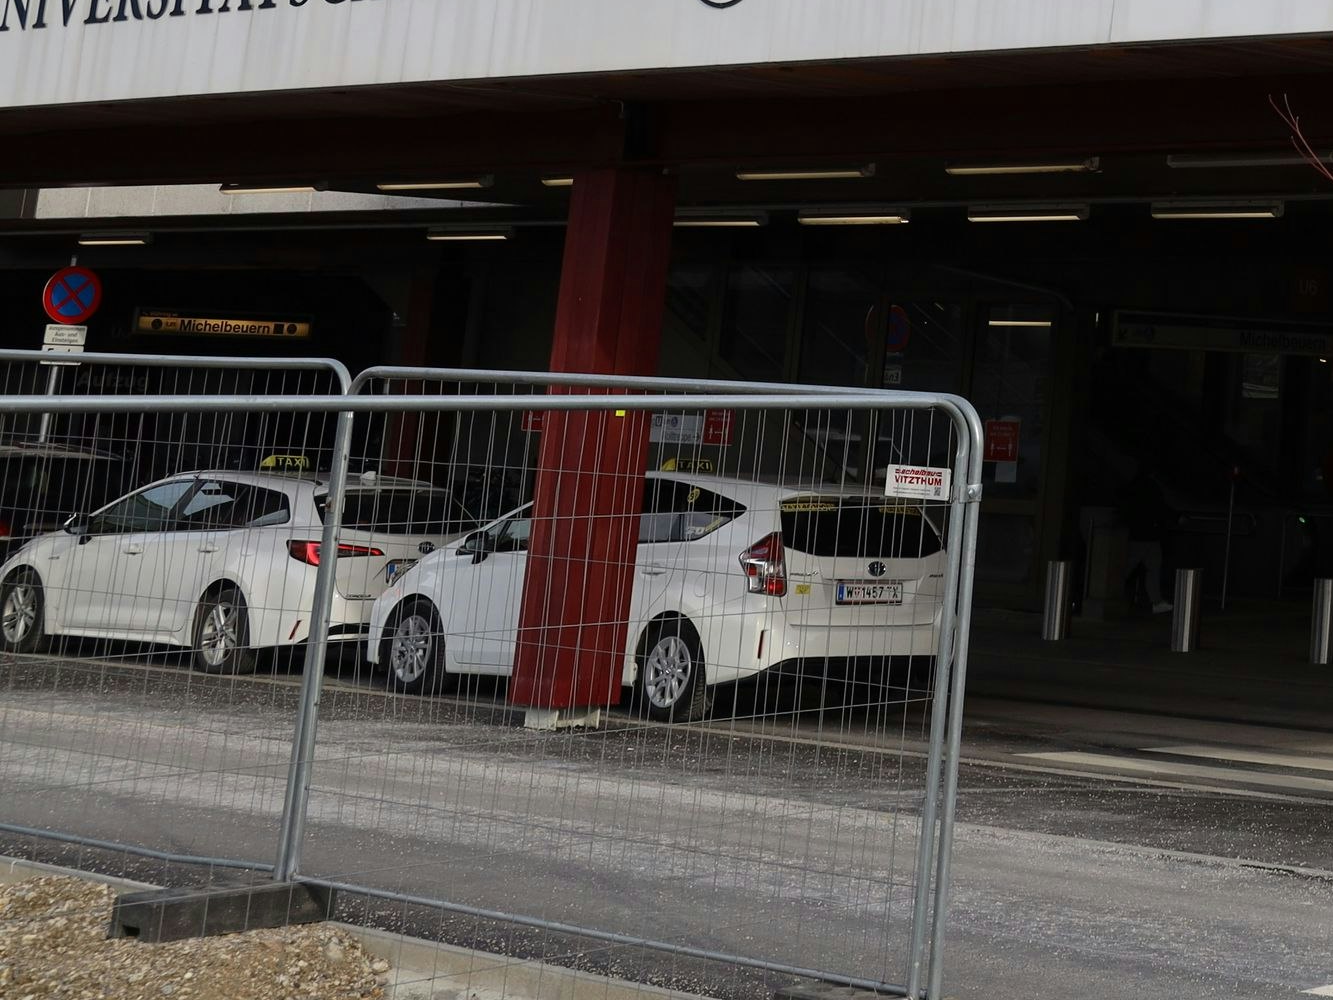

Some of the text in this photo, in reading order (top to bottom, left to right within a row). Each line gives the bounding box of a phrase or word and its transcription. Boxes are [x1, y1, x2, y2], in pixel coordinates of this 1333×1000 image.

[179, 319, 271, 335] Michelbeuern
[277, 457, 306, 467] TAXI
[895, 475, 942, 486] VITZTHUM
